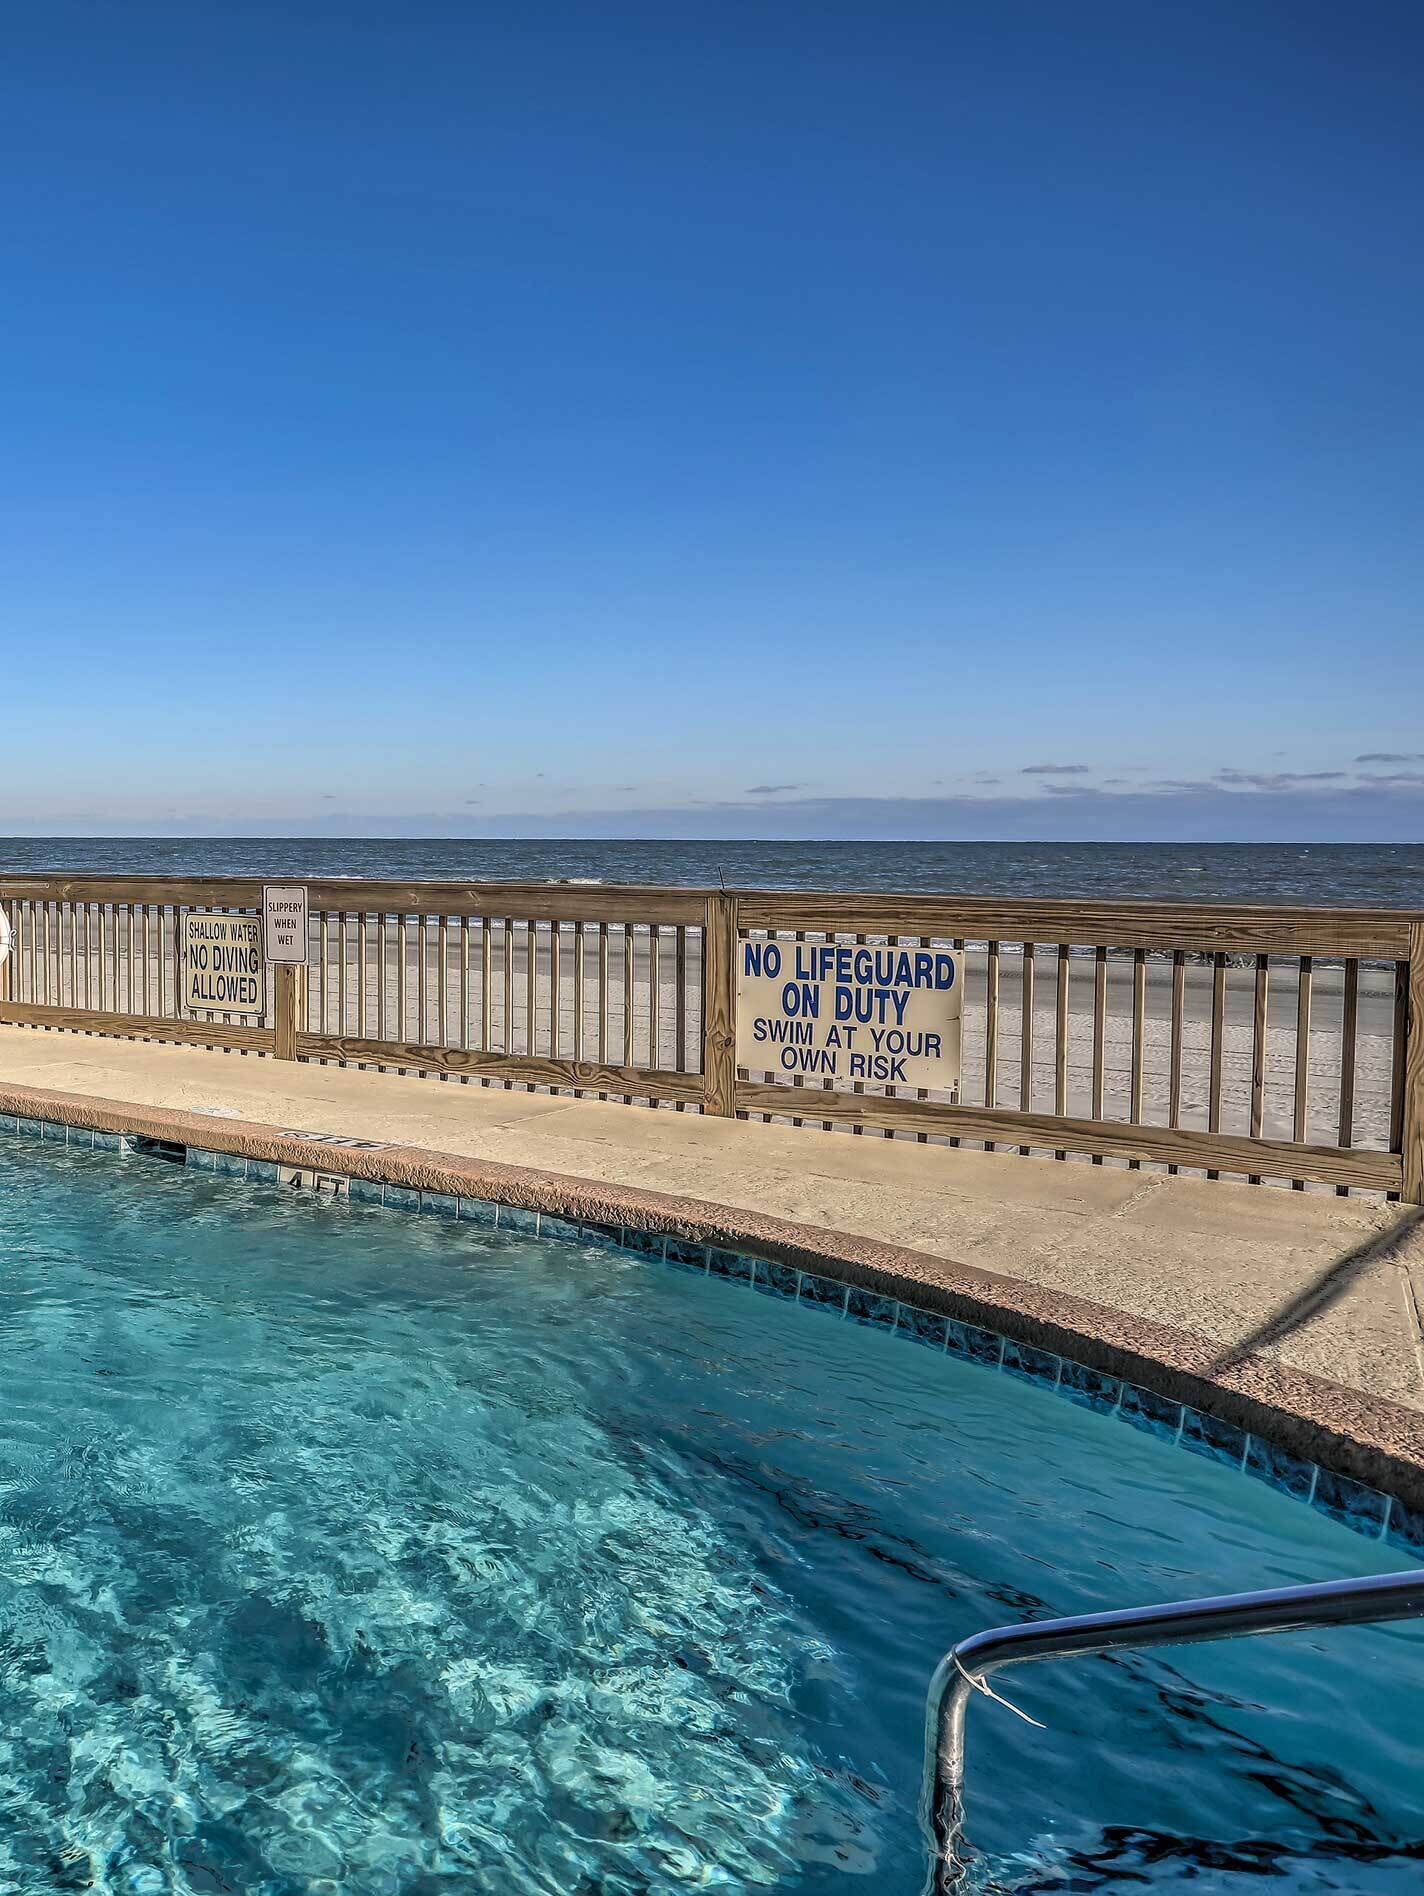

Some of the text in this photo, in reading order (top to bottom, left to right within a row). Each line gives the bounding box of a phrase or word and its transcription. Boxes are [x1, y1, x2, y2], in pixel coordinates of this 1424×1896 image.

[268, 902, 302, 912] SLIPPERY
[189, 922, 258, 942] SHALLOW WATER
[274, 919, 296, 929] WHEN
[278, 935, 293, 945] WET
[190, 944, 258, 974] NO DIVING
[744, 943, 955, 990] NO LIFEGUARD
[192, 973, 257, 1003] ALLOWED
[782, 982, 911, 1025] ON DUTY
[753, 1018, 942, 1058] SWIM AT YOUR
[780, 1046, 908, 1083] OWN RISK
[287, 1171, 345, 1196] 4 FT
